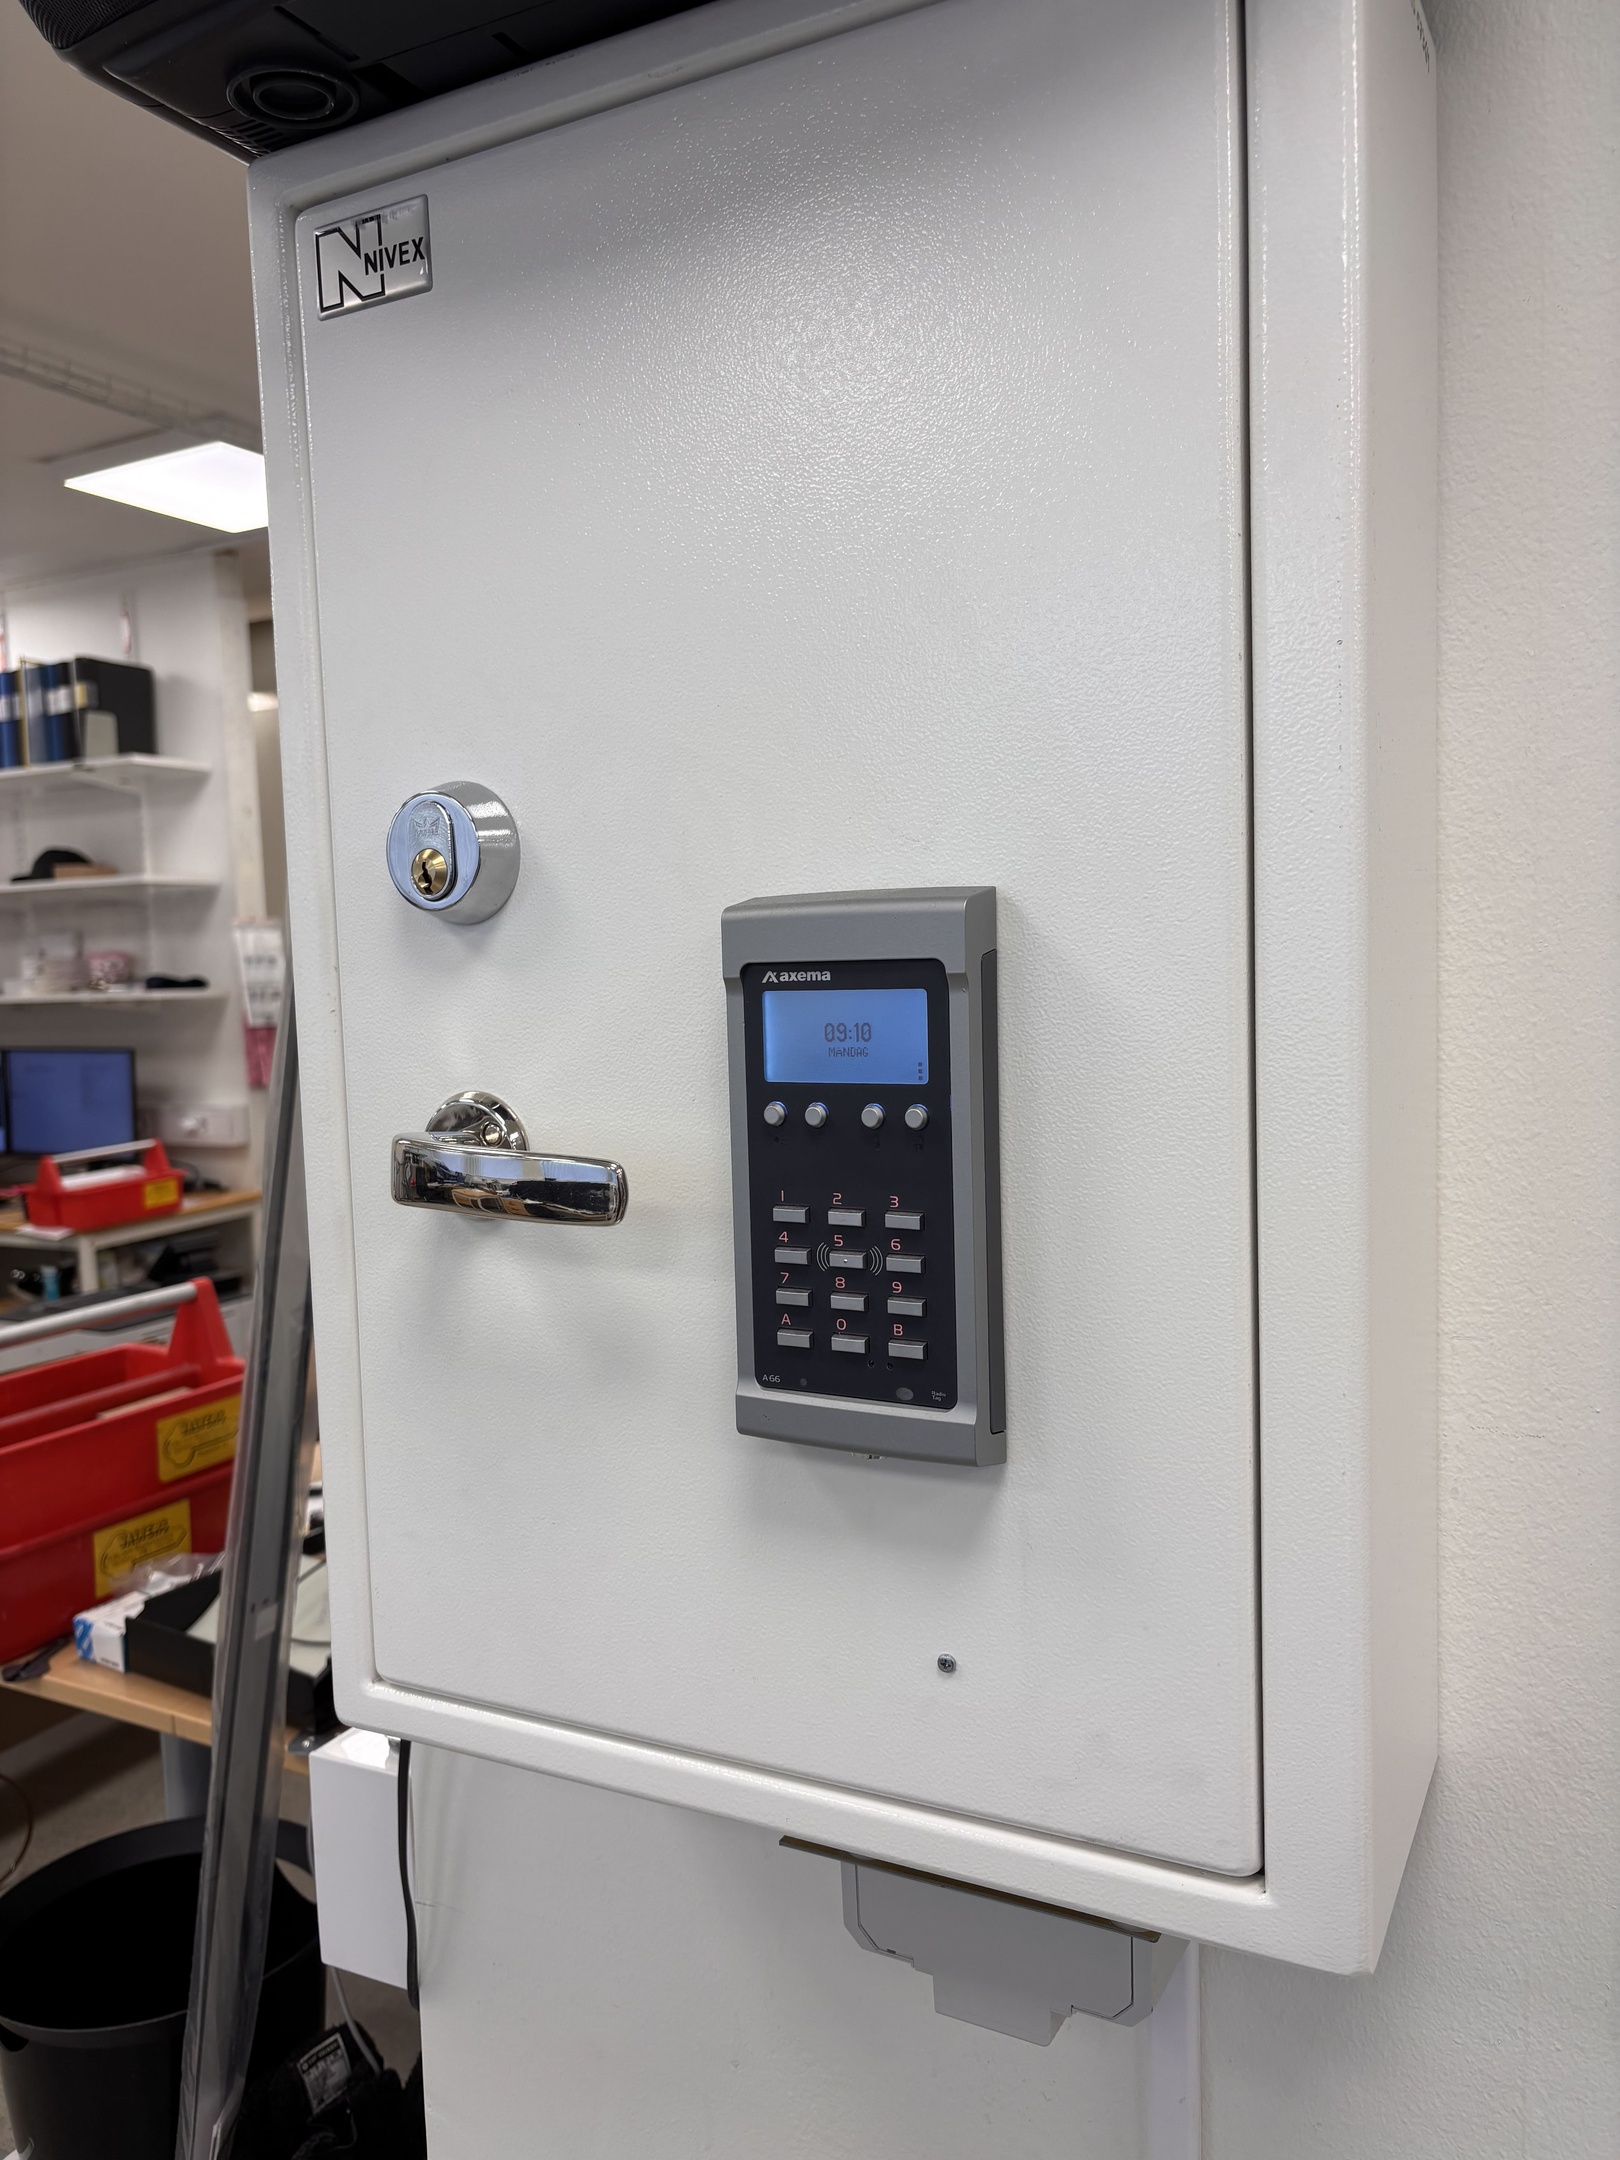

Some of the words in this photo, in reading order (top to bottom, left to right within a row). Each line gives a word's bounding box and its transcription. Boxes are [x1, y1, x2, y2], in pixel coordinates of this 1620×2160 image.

[363, 236, 426, 276] NIVEX
[779, 970, 832, 982] axema
[824, 1022, 872, 1043] 09:10
[832, 1192, 842, 1205] 2
[889, 1195, 899, 1208] 3
[778, 1231, 789, 1243] 4
[833, 1234, 844, 1247] 5
[890, 1238, 901, 1251] 6
[780, 1271, 789, 1284] 7
[835, 1276, 846, 1289] 8
[891, 1281, 902, 1294] 9
[781, 1313, 791, 1326] A
[893, 1323, 904, 1337] B
